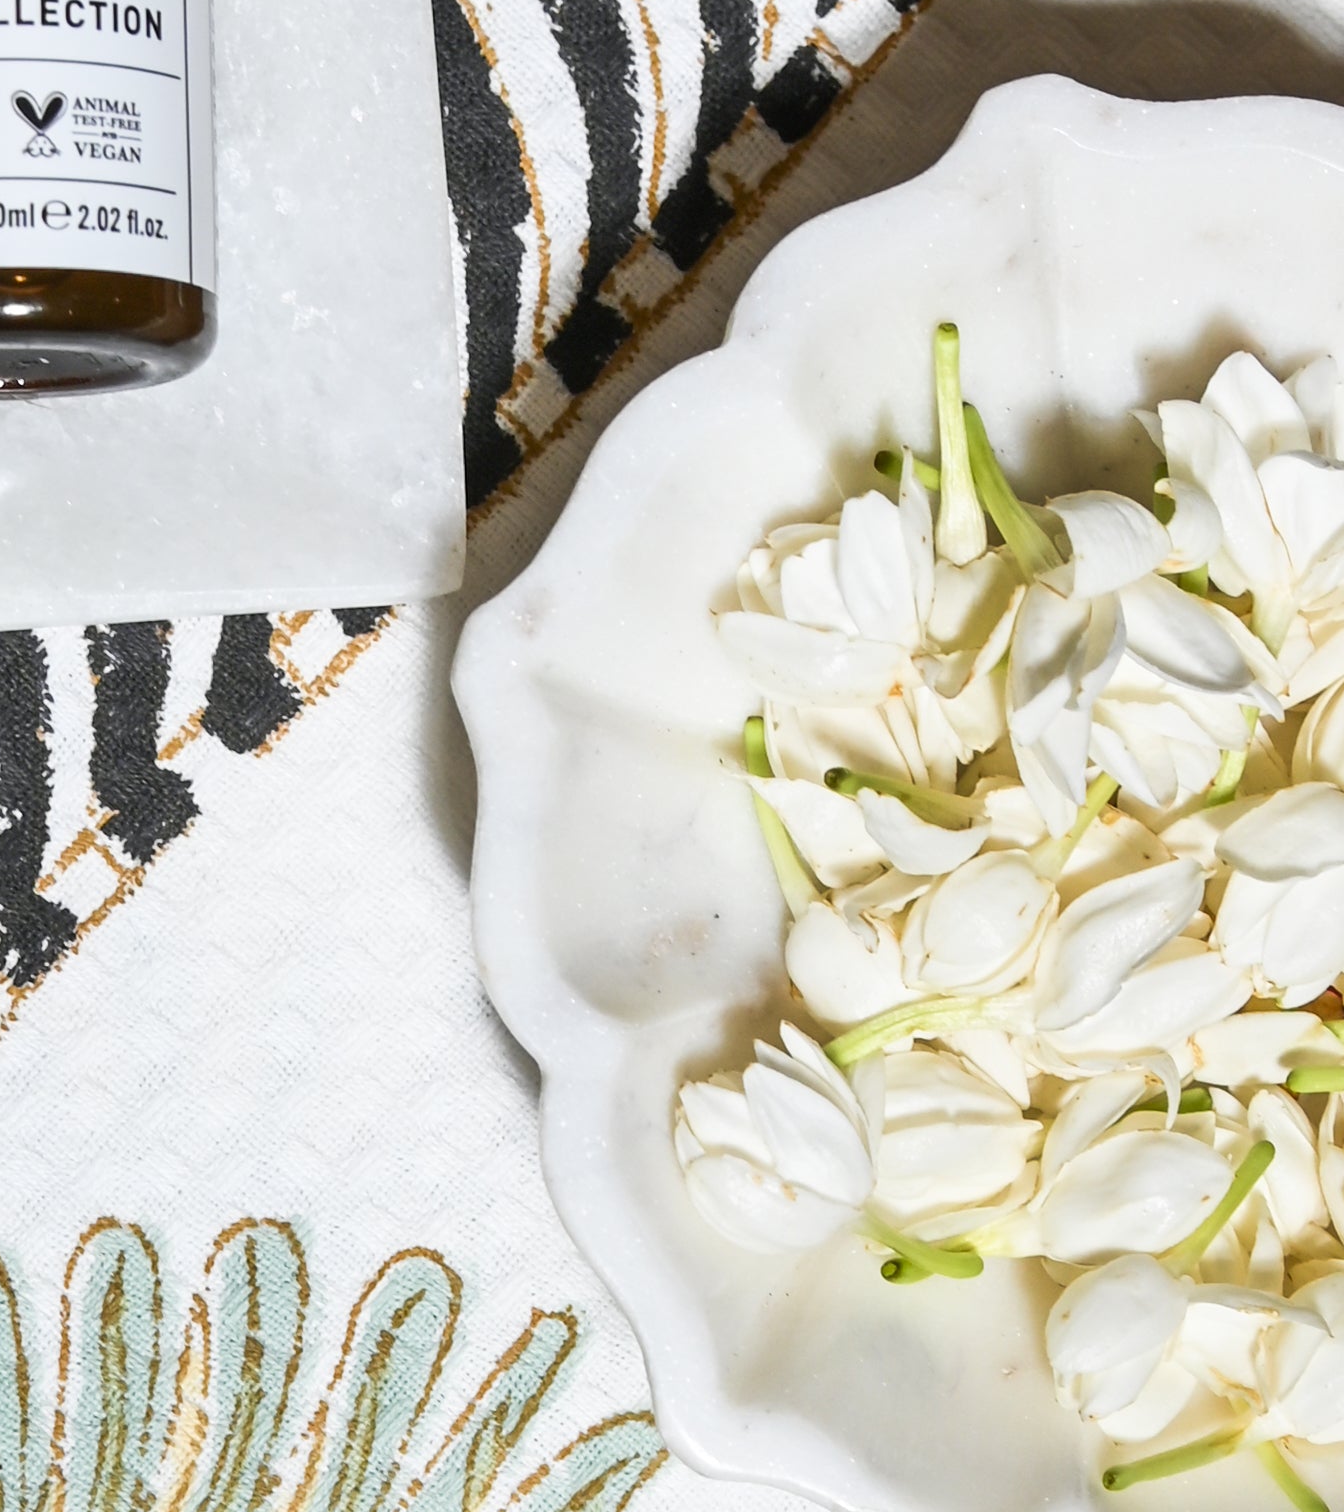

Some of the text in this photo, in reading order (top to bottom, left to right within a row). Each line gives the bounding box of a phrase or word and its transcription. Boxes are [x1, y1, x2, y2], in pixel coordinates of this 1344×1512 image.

[72, 96, 141, 117] ANIMAL
[71, 113, 142, 132] TEST-FREE
[73, 140, 142, 164] VEGAN
[78, 205, 121, 233] 2.02
[127, 209, 168, 240] fl.oz.
